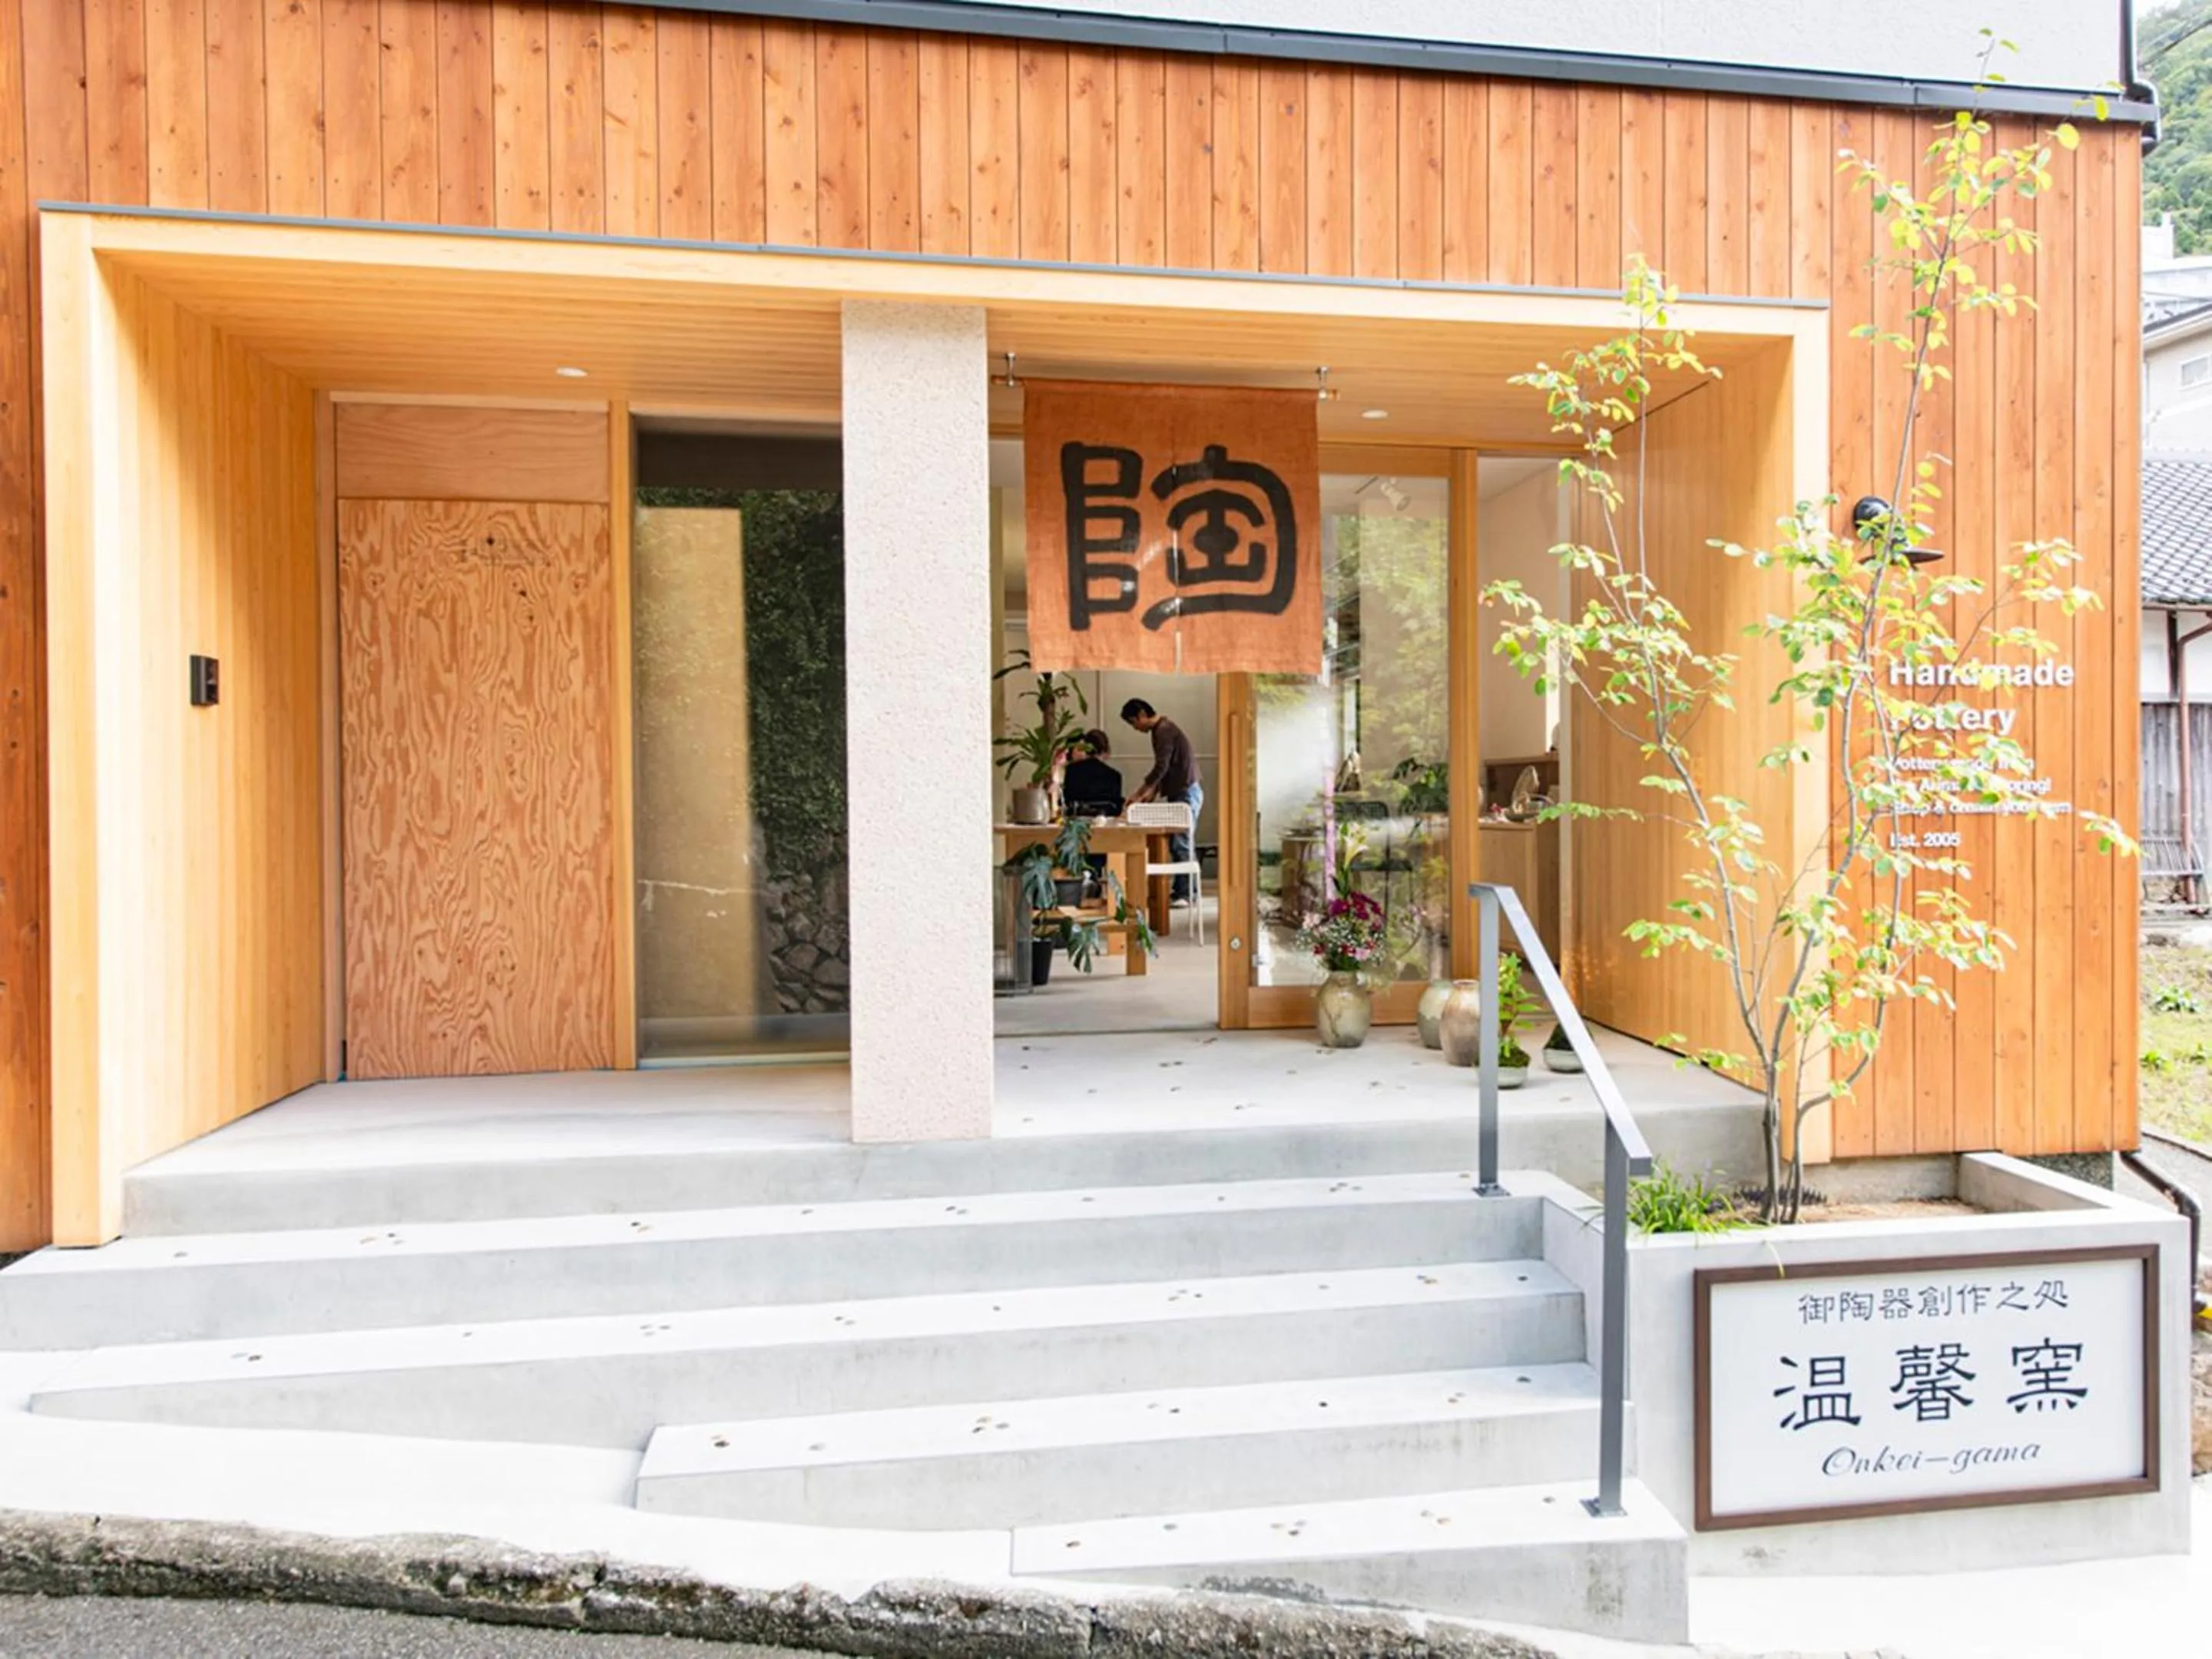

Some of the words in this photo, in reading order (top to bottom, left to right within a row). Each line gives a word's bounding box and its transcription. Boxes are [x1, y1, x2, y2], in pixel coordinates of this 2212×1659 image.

[1798, 1280, 2068, 1324] 御陶器創作之処
[1773, 1337, 2088, 1431] 温馨窯
